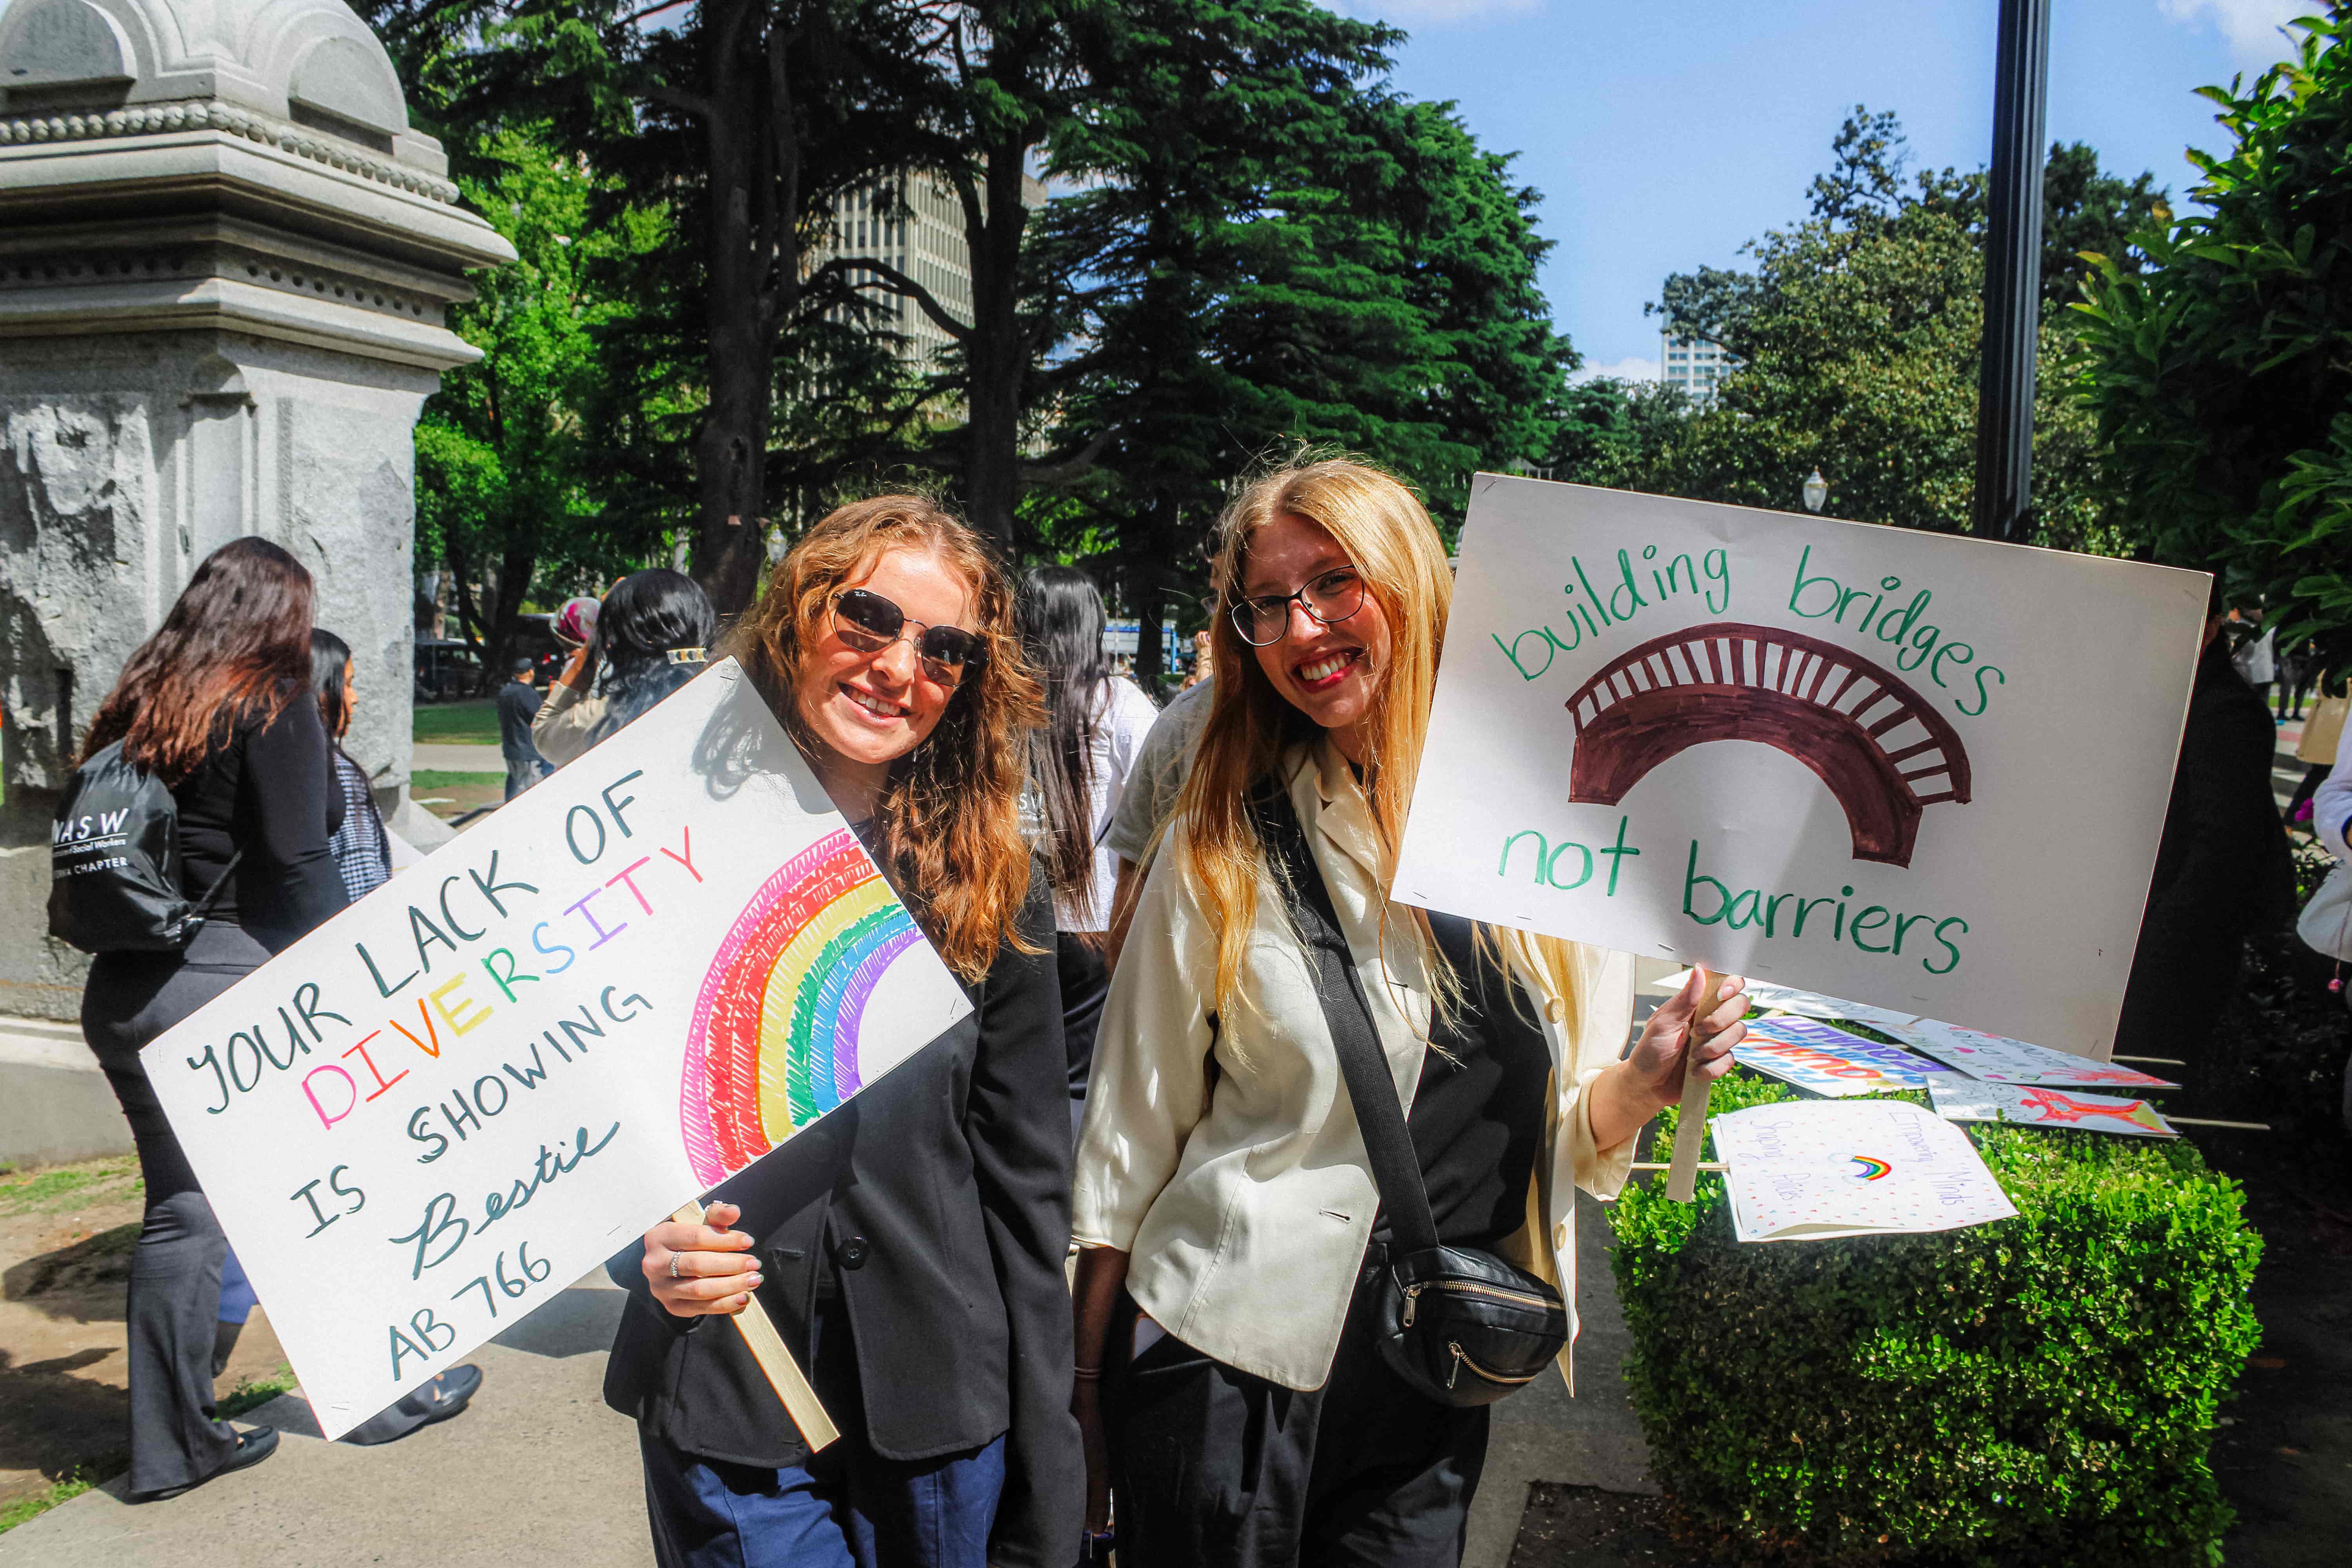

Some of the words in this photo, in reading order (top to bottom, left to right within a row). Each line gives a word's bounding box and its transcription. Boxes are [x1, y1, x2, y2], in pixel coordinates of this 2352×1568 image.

[1491, 545, 1730, 681] building
[1789, 545, 2005, 716] bridges
[72, 842, 94, 854] Social
[94, 838, 127, 849] Workers
[74, 857, 128, 874] CHAPTER
[1499, 815, 1641, 897] not
[1683, 840, 1969, 974] barriers
[187, 983, 352, 1114] YOUR
[355, 849, 540, 998] LACK
[566, 770, 643, 864] OF
[301, 826, 703, 1131] DIVERSITY
[290, 1165, 365, 1238] IS
[407, 986, 652, 1163] SHOWING
[1738, 1120, 1794, 1160] Shaping
[389, 1121, 620, 1280] Bestie
[1765, 1173, 1811, 1201] Policies
[1924, 1171, 1975, 1205] Minds
[389, 1308, 455, 1381] AB
[451, 1241, 551, 1318] 766
